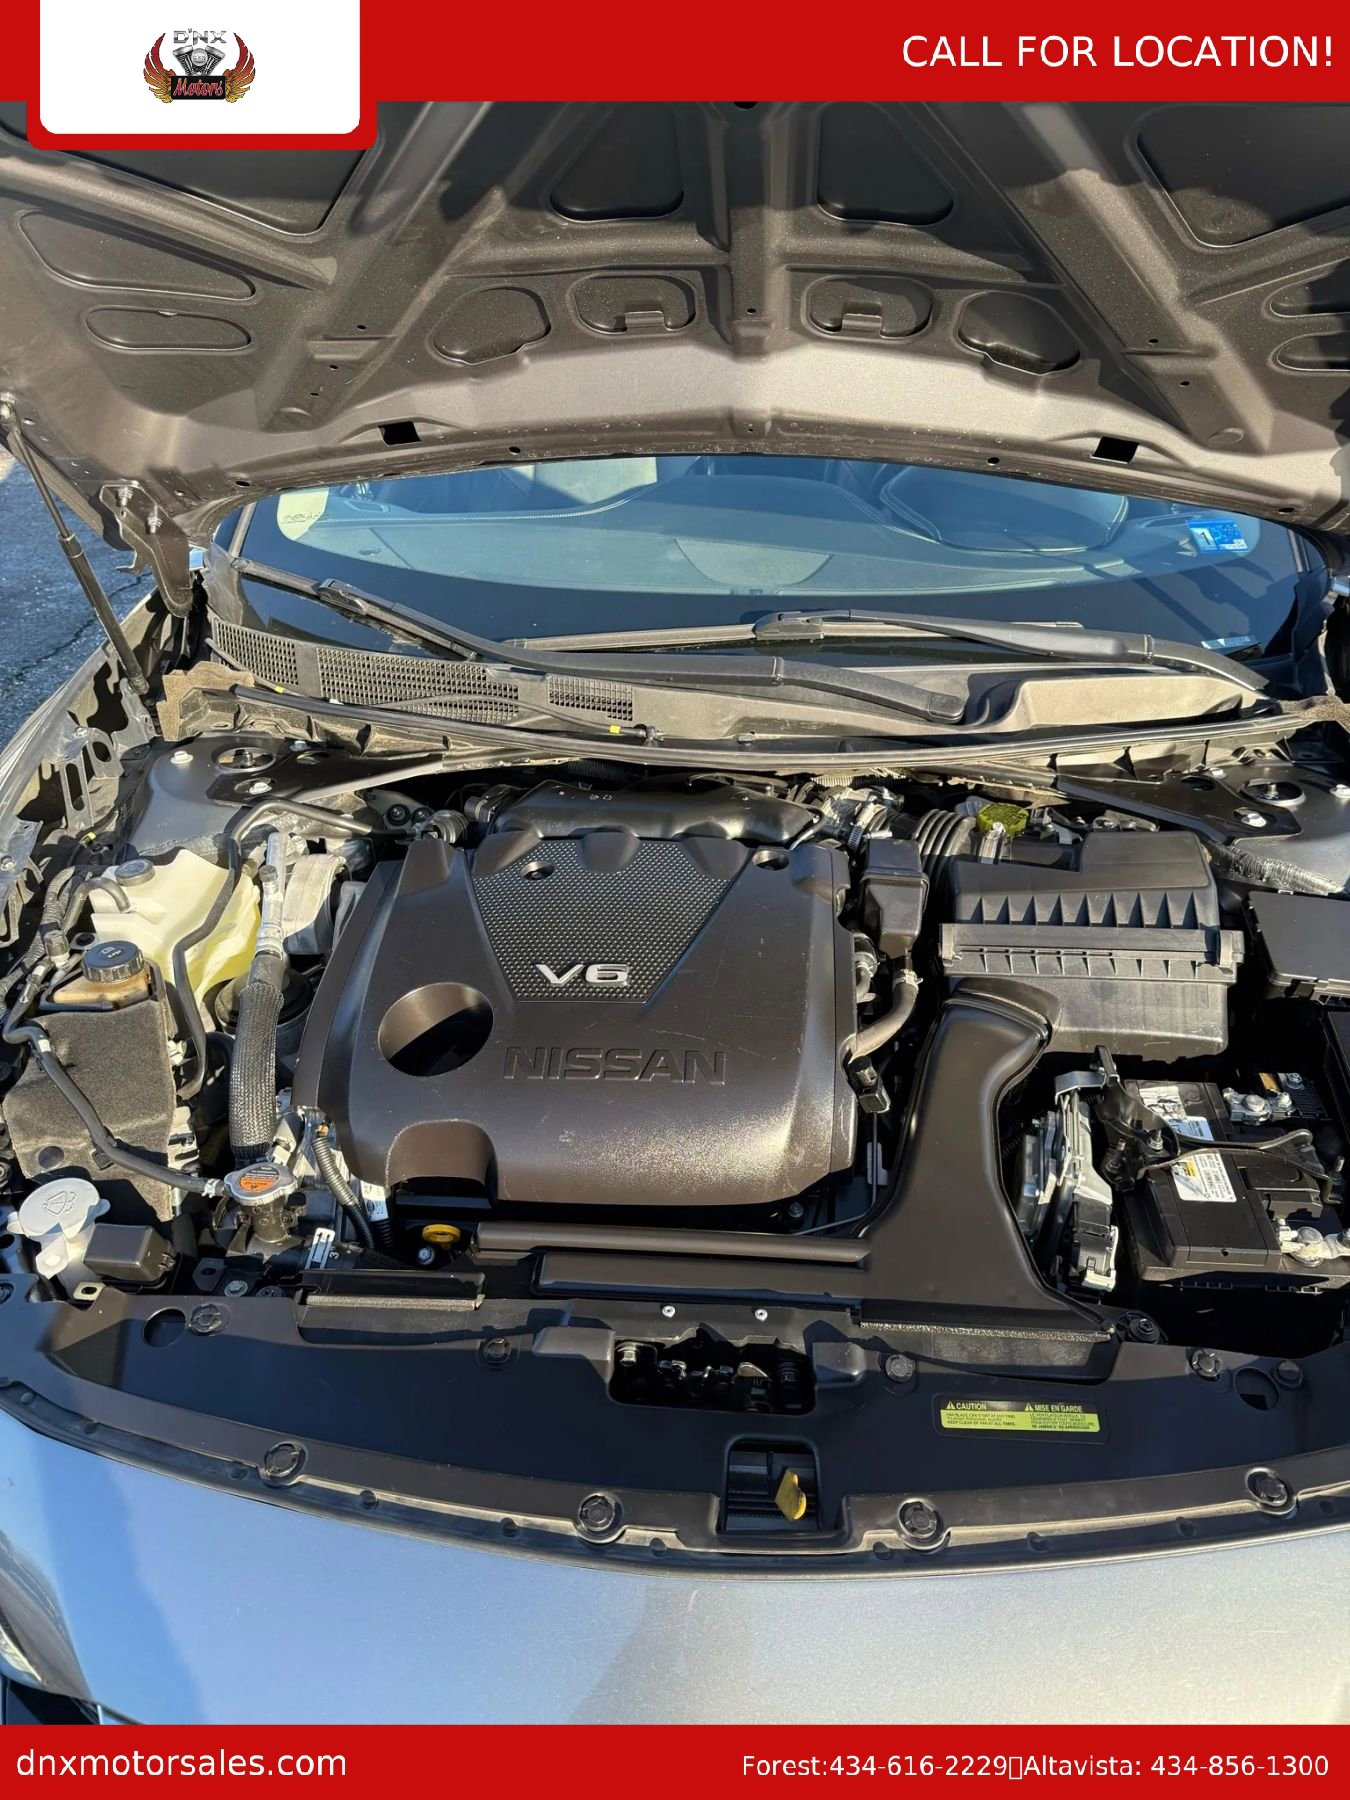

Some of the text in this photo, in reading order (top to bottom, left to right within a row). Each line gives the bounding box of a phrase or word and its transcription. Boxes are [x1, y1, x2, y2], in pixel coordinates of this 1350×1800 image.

[536, 963, 630, 987] V6
[503, 1046, 727, 1086] NISSAN
[956, 1402, 987, 1410] CAUTION
[1060, 1405, 1083, 1413] GARDE
